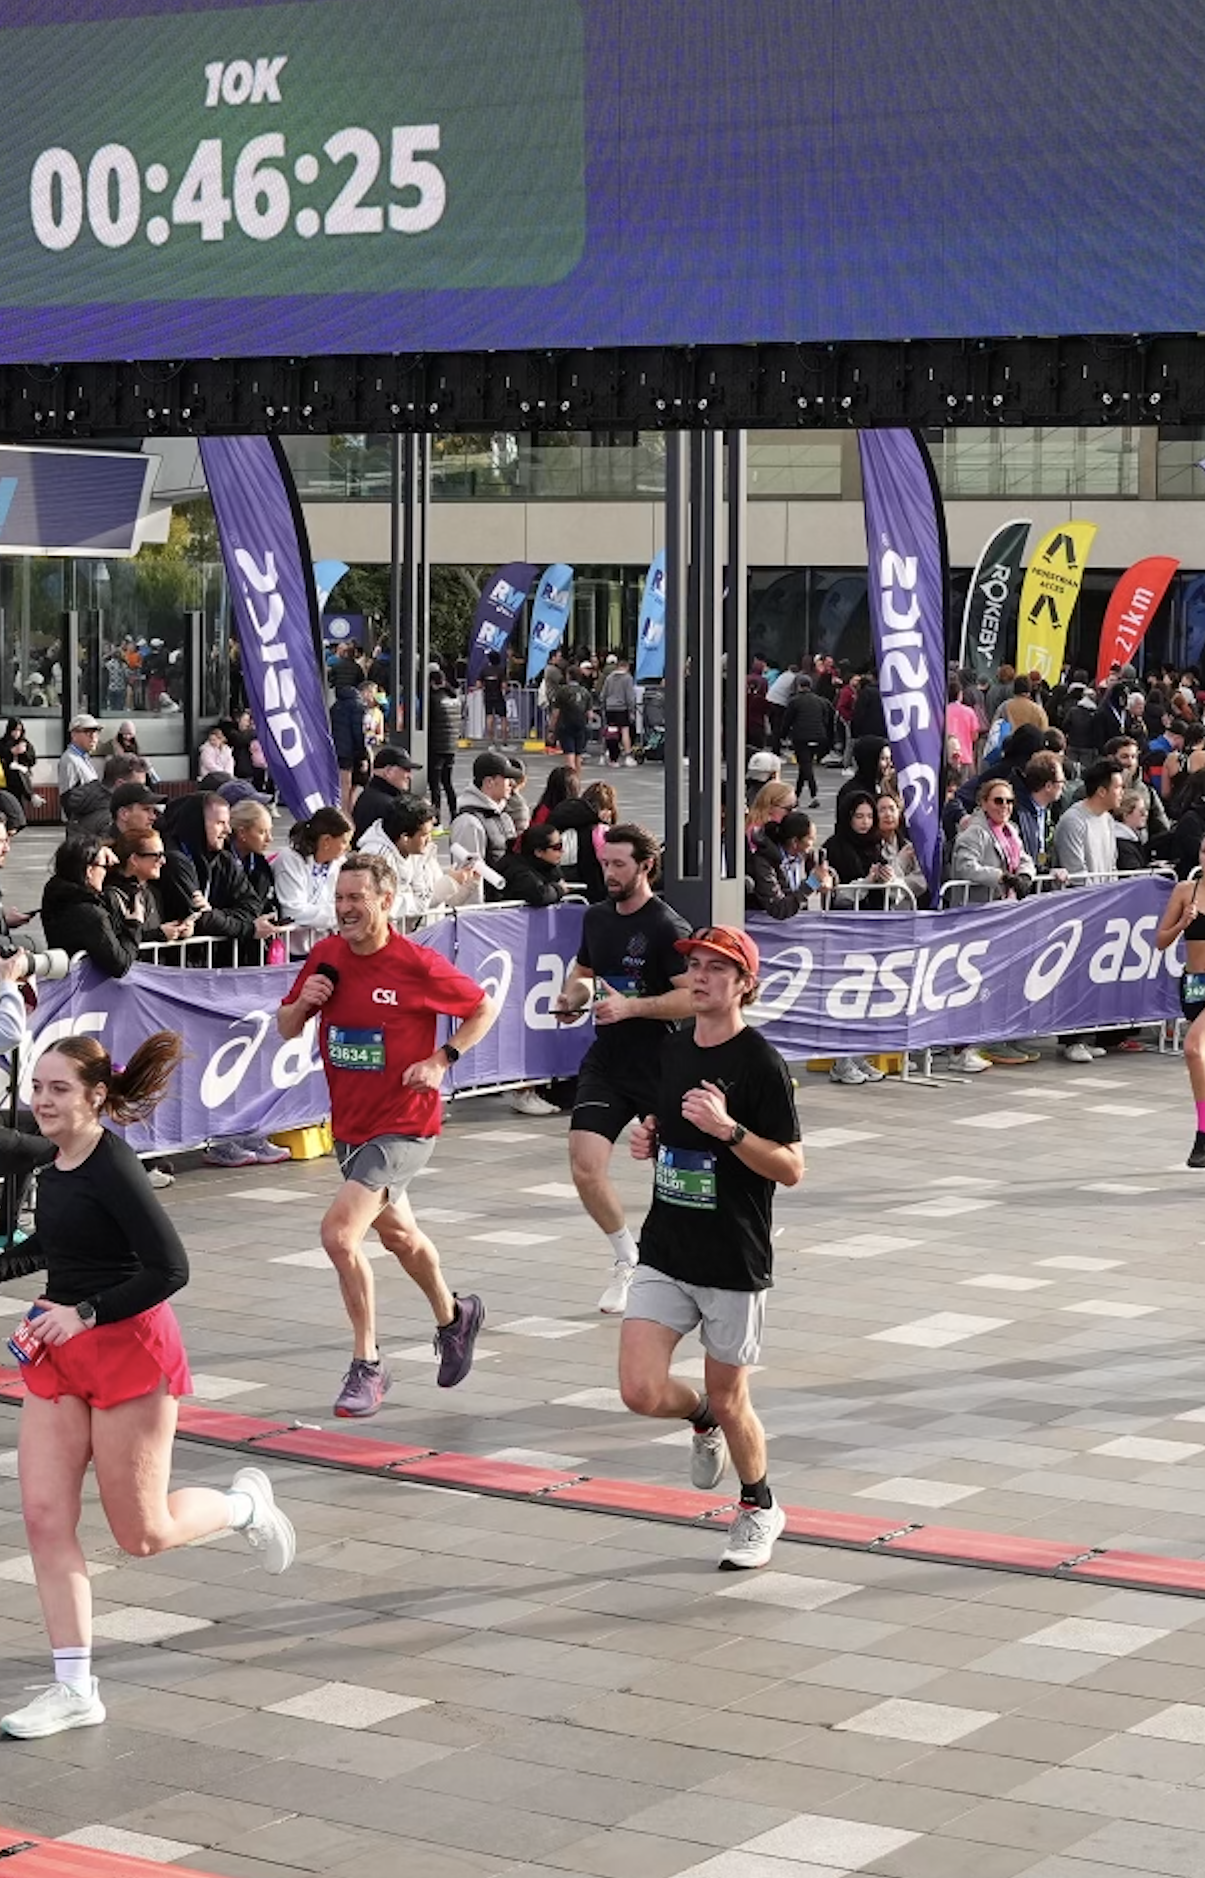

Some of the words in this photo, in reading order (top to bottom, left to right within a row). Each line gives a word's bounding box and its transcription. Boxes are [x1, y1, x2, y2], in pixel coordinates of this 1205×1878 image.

[204, 55, 289, 107] 10K
[30, 123, 447, 251] 00:46:25
[977, 563, 1012, 663] ROKEBY
[371, 987, 399, 1006] CSL
[825, 939, 991, 1020] asics
